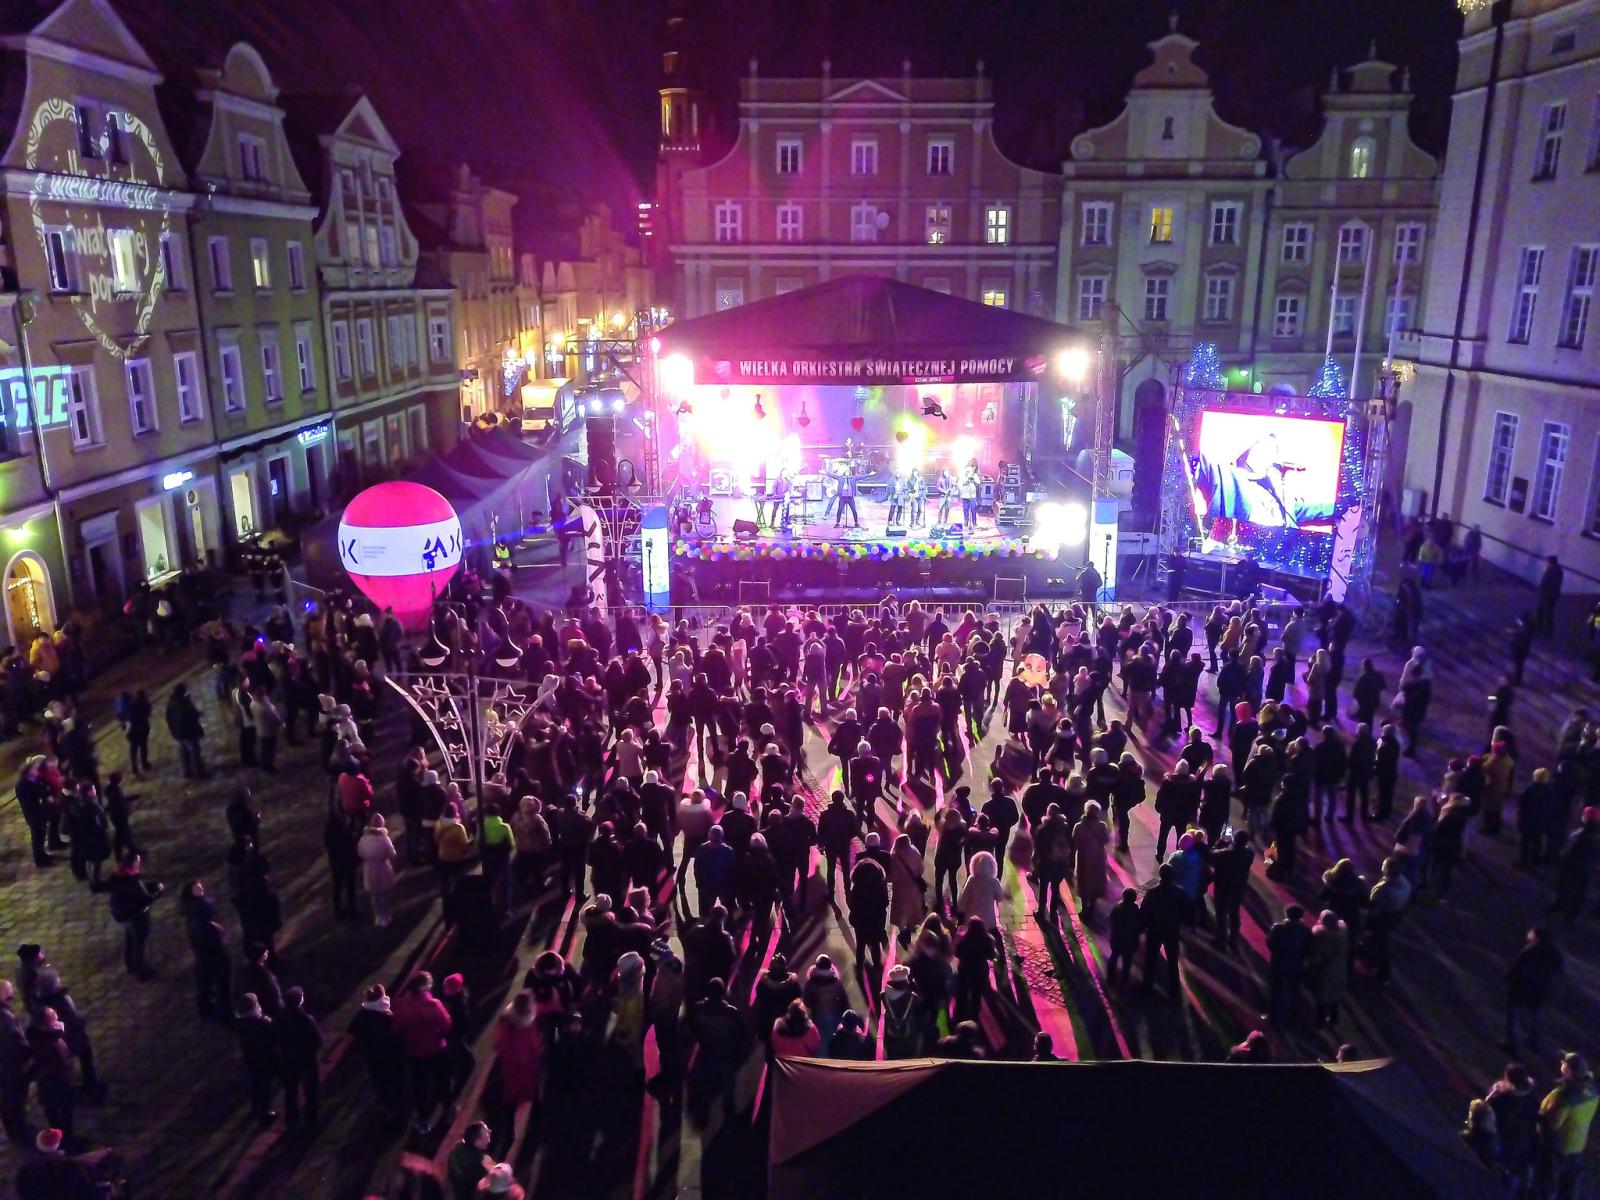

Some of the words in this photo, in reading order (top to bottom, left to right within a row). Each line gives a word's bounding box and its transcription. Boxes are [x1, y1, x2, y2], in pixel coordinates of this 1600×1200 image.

[739, 360, 788, 377] WIELKA
[792, 360, 861, 377] ORKIESTRA
[960, 358, 1014, 375] POMOCY
